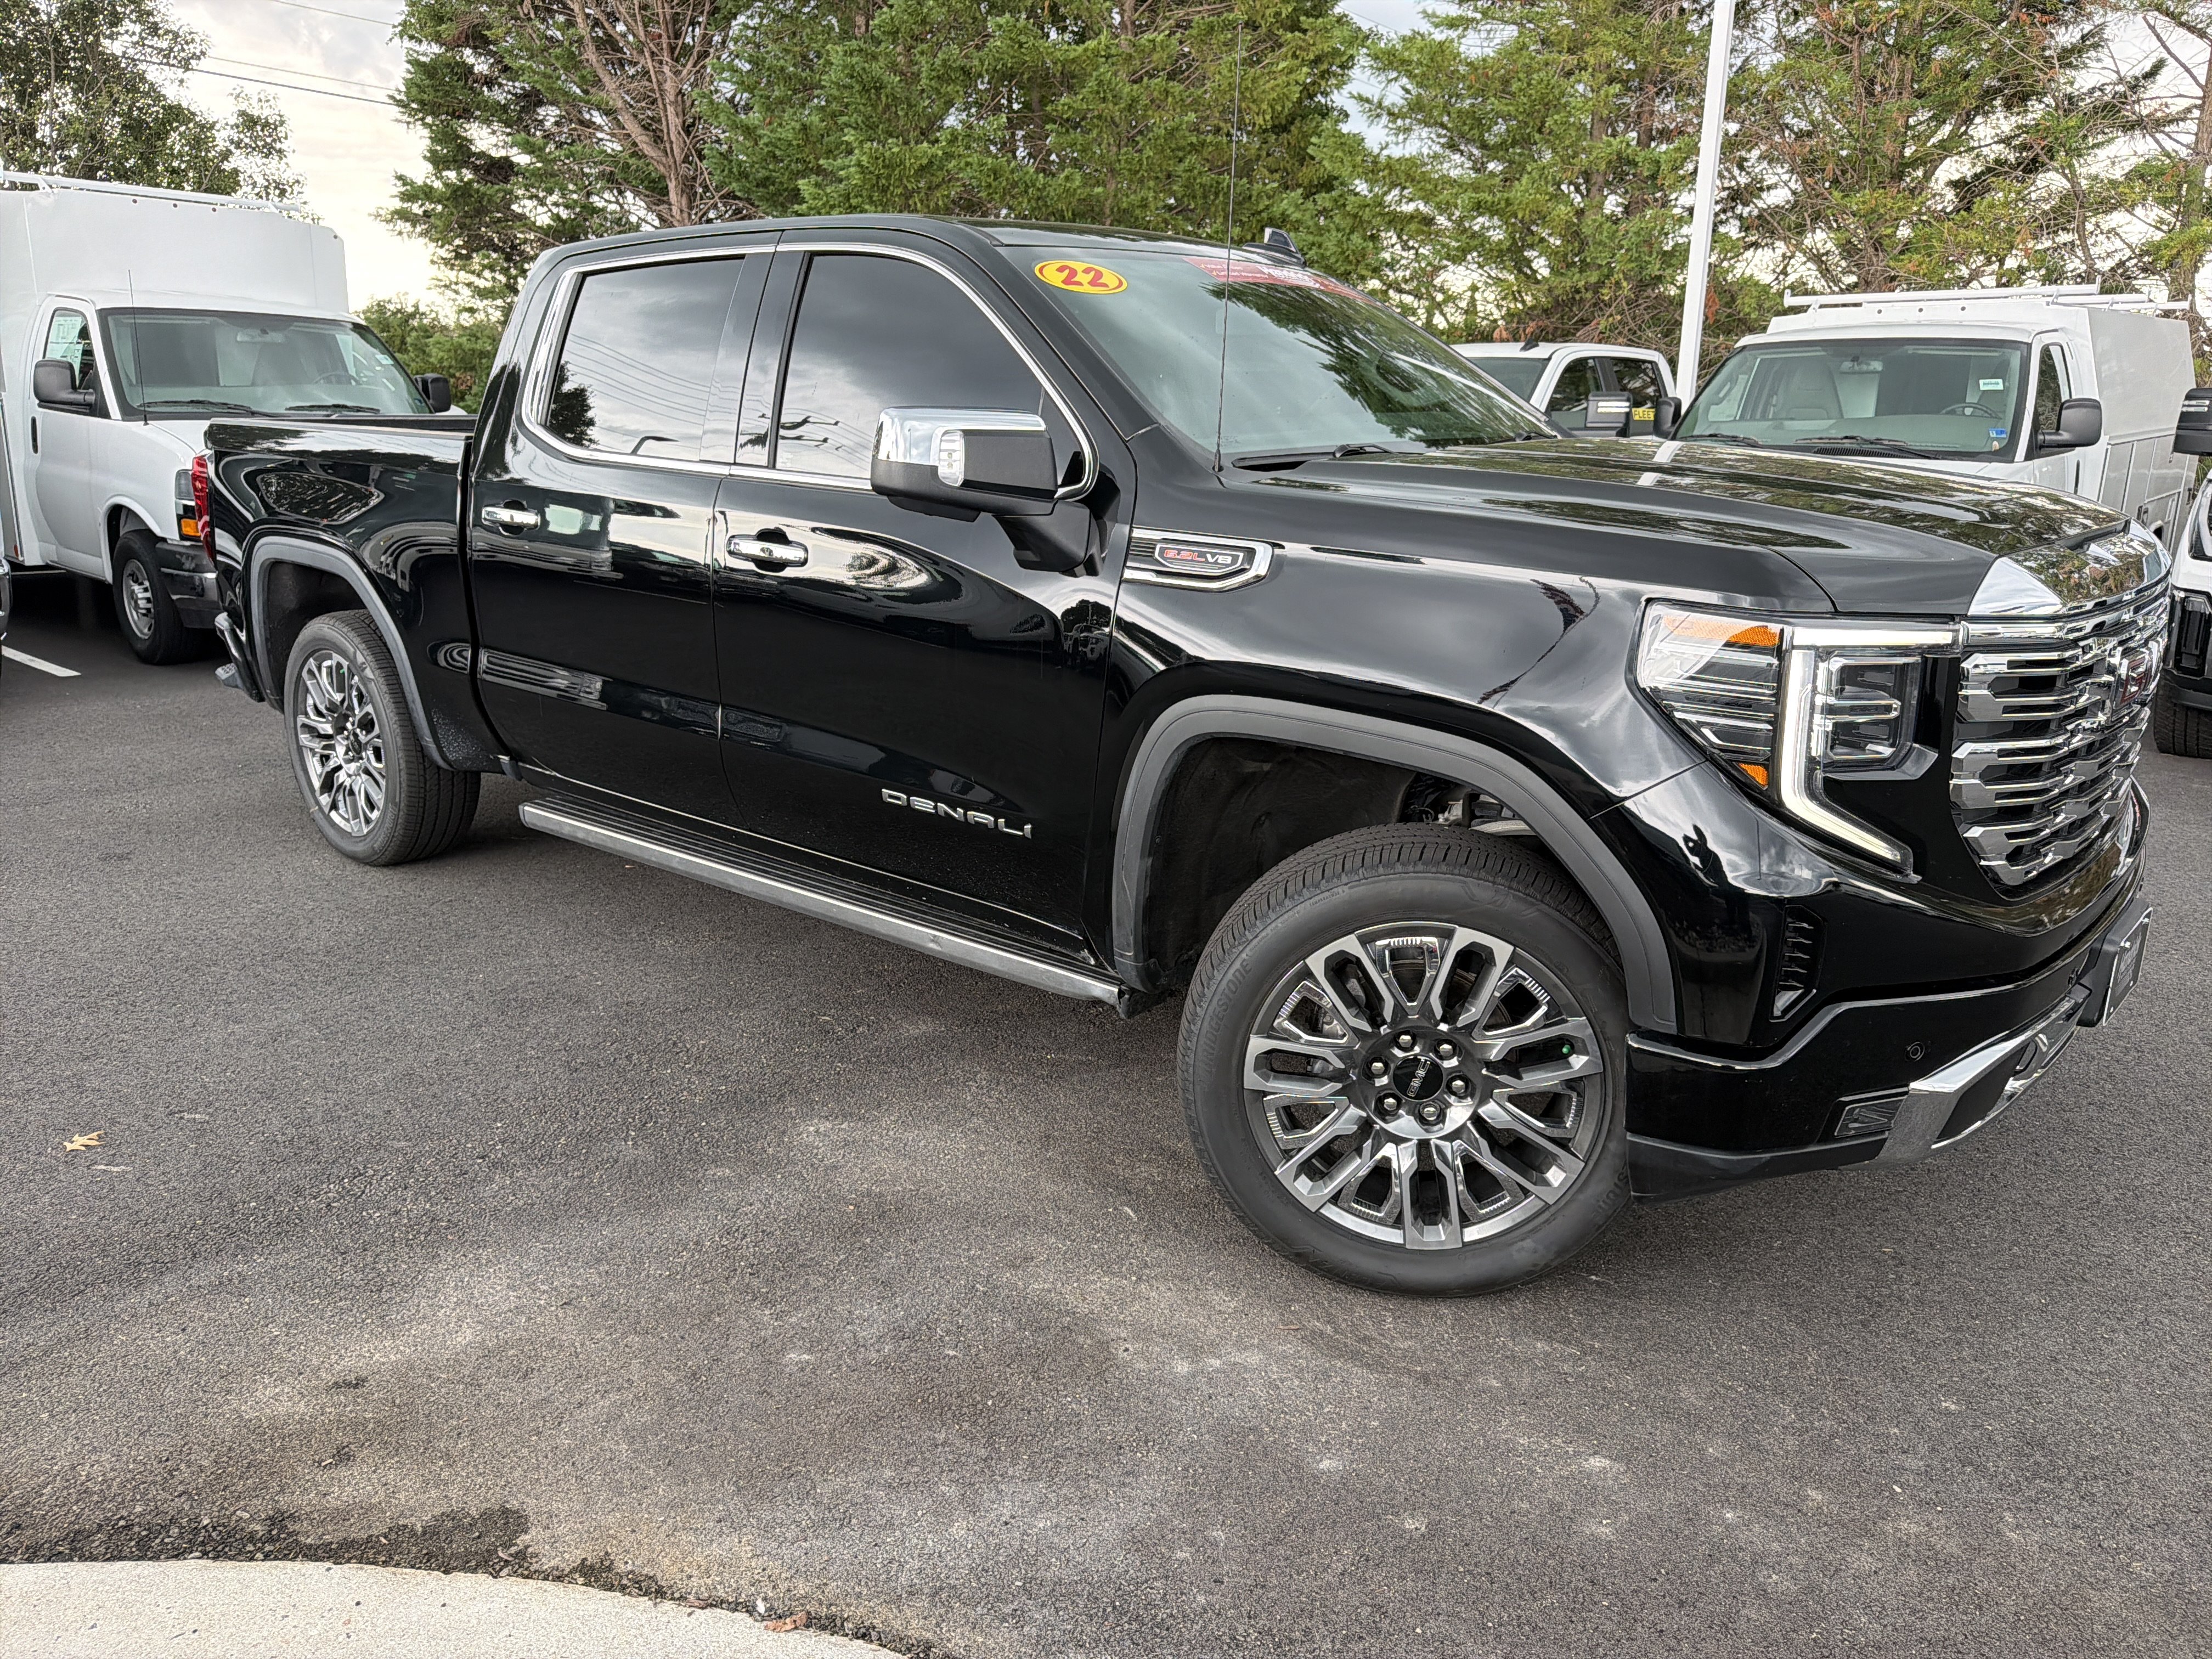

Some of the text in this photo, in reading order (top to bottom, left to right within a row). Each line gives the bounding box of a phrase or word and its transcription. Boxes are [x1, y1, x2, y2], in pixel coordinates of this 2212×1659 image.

[1056, 264, 1110, 288] 22
[1164, 549, 1232, 564] 6.2L V8
[882, 788, 1032, 839] DENALI
[1406, 1059, 1430, 1097] GMC
